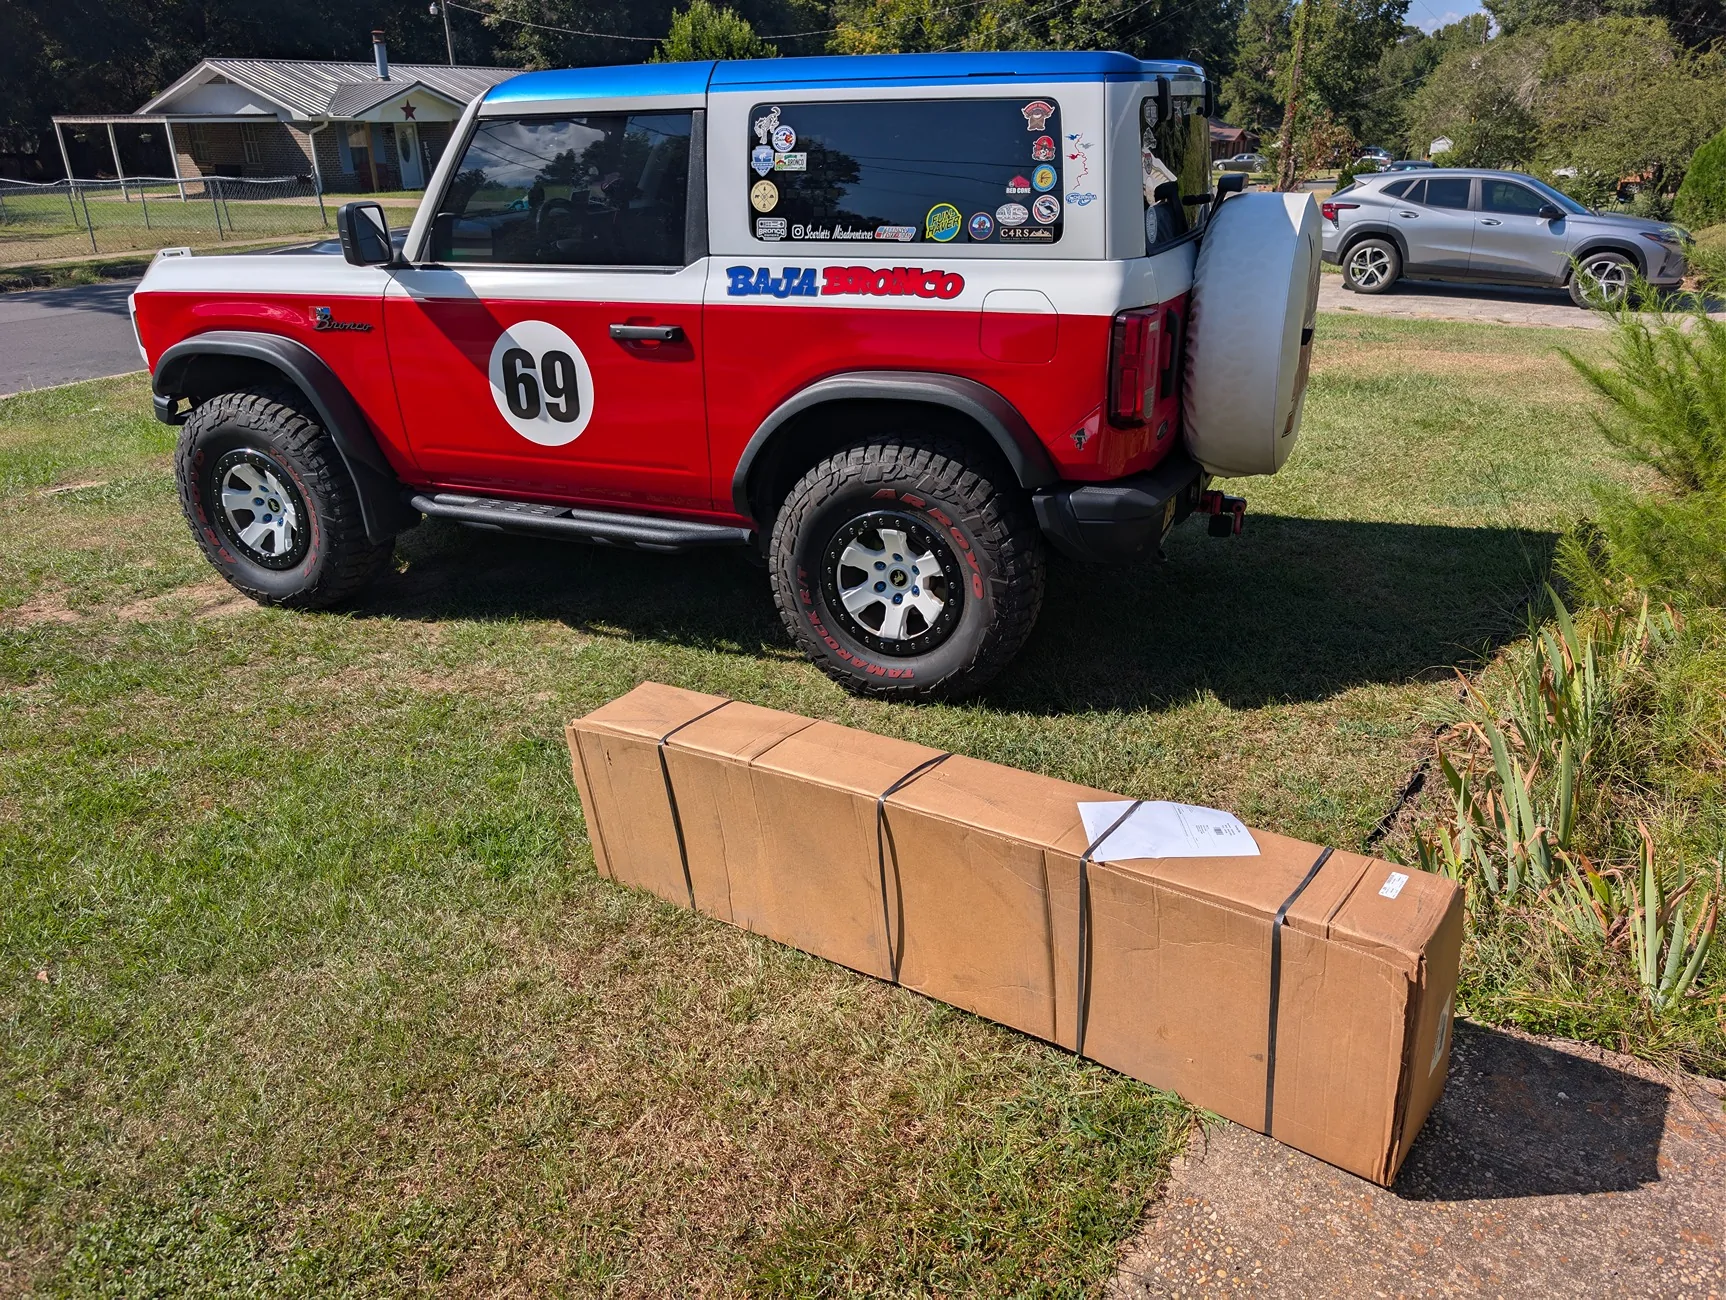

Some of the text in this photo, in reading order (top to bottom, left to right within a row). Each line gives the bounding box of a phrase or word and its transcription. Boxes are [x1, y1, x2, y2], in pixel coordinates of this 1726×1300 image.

[832, 224, 874, 239] Misadventures
[1000, 228, 1030, 238] C4RS
[726, 265, 965, 300] BAJA BRONCO
[314, 314, 372, 330] Bronco
[502, 347, 580, 422] 69
[870, 488, 985, 600] ARROYO
[806, 610, 915, 680] TAMAROCK
